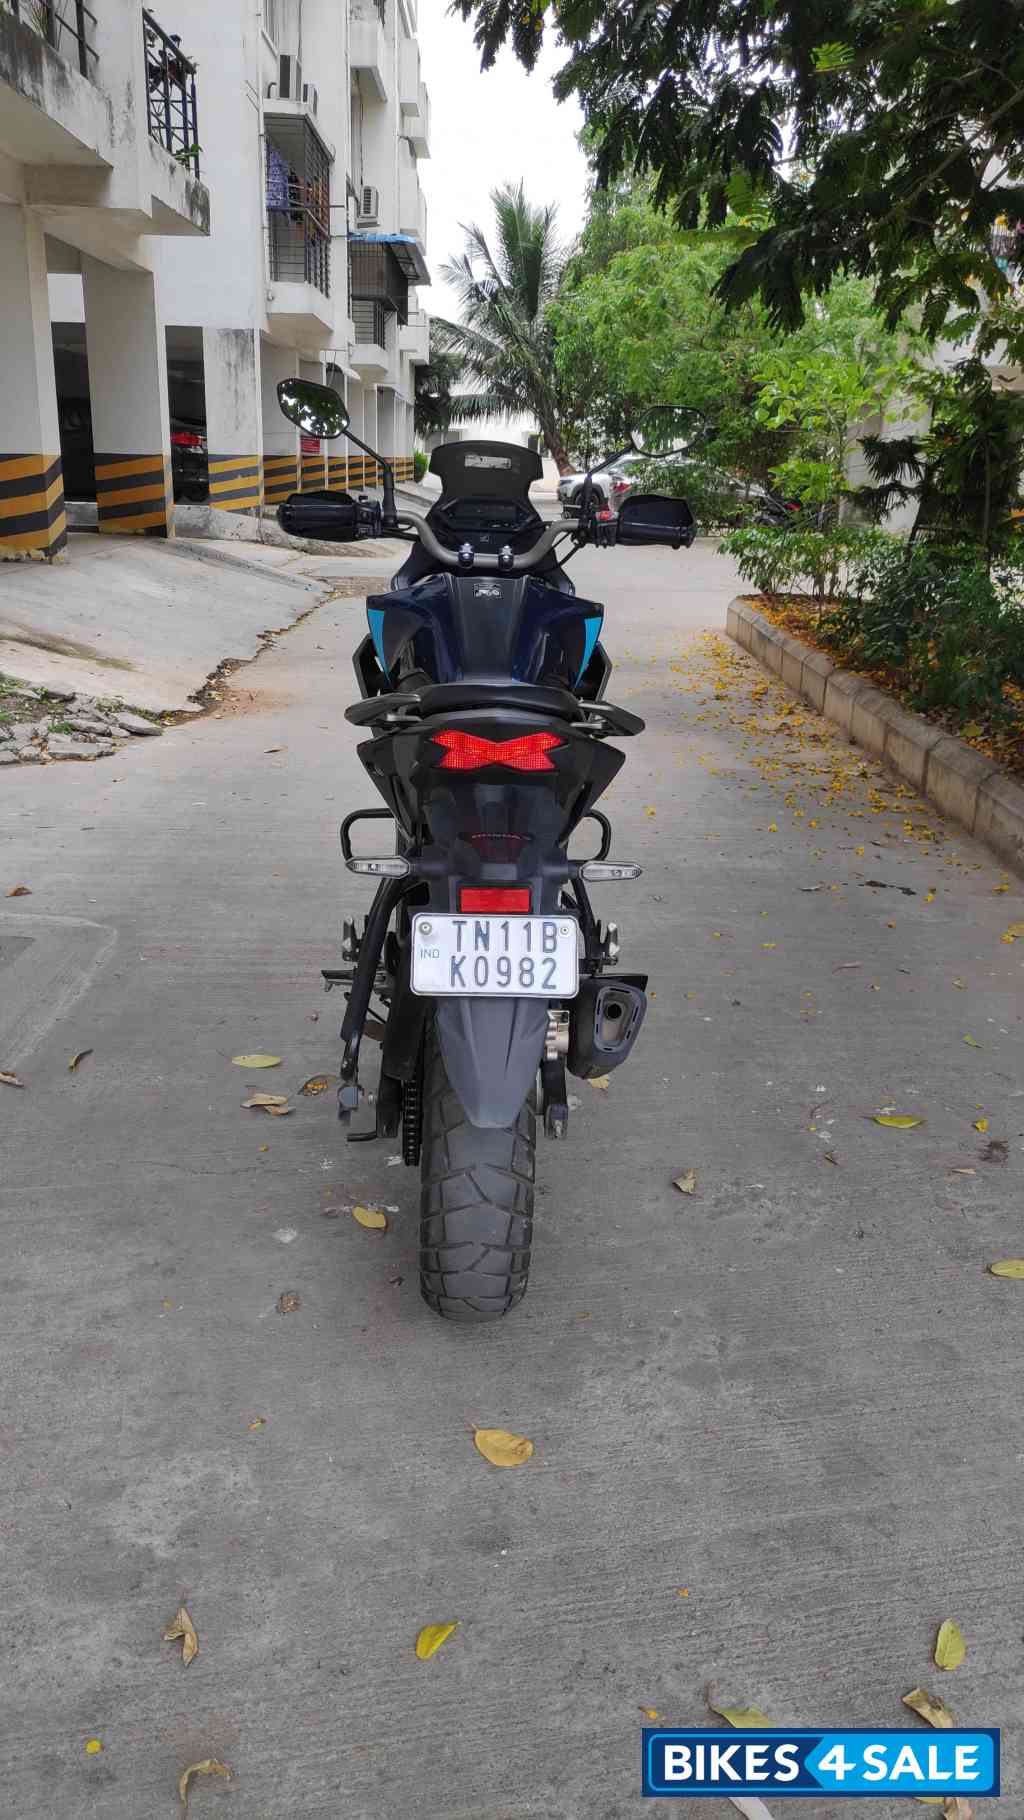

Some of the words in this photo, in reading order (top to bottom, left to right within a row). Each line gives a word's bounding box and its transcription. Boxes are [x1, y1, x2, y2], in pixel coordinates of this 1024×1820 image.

[452, 920, 557, 953] TN11B
[419, 948, 440, 959] IND
[450, 955, 557, 989] K0982
